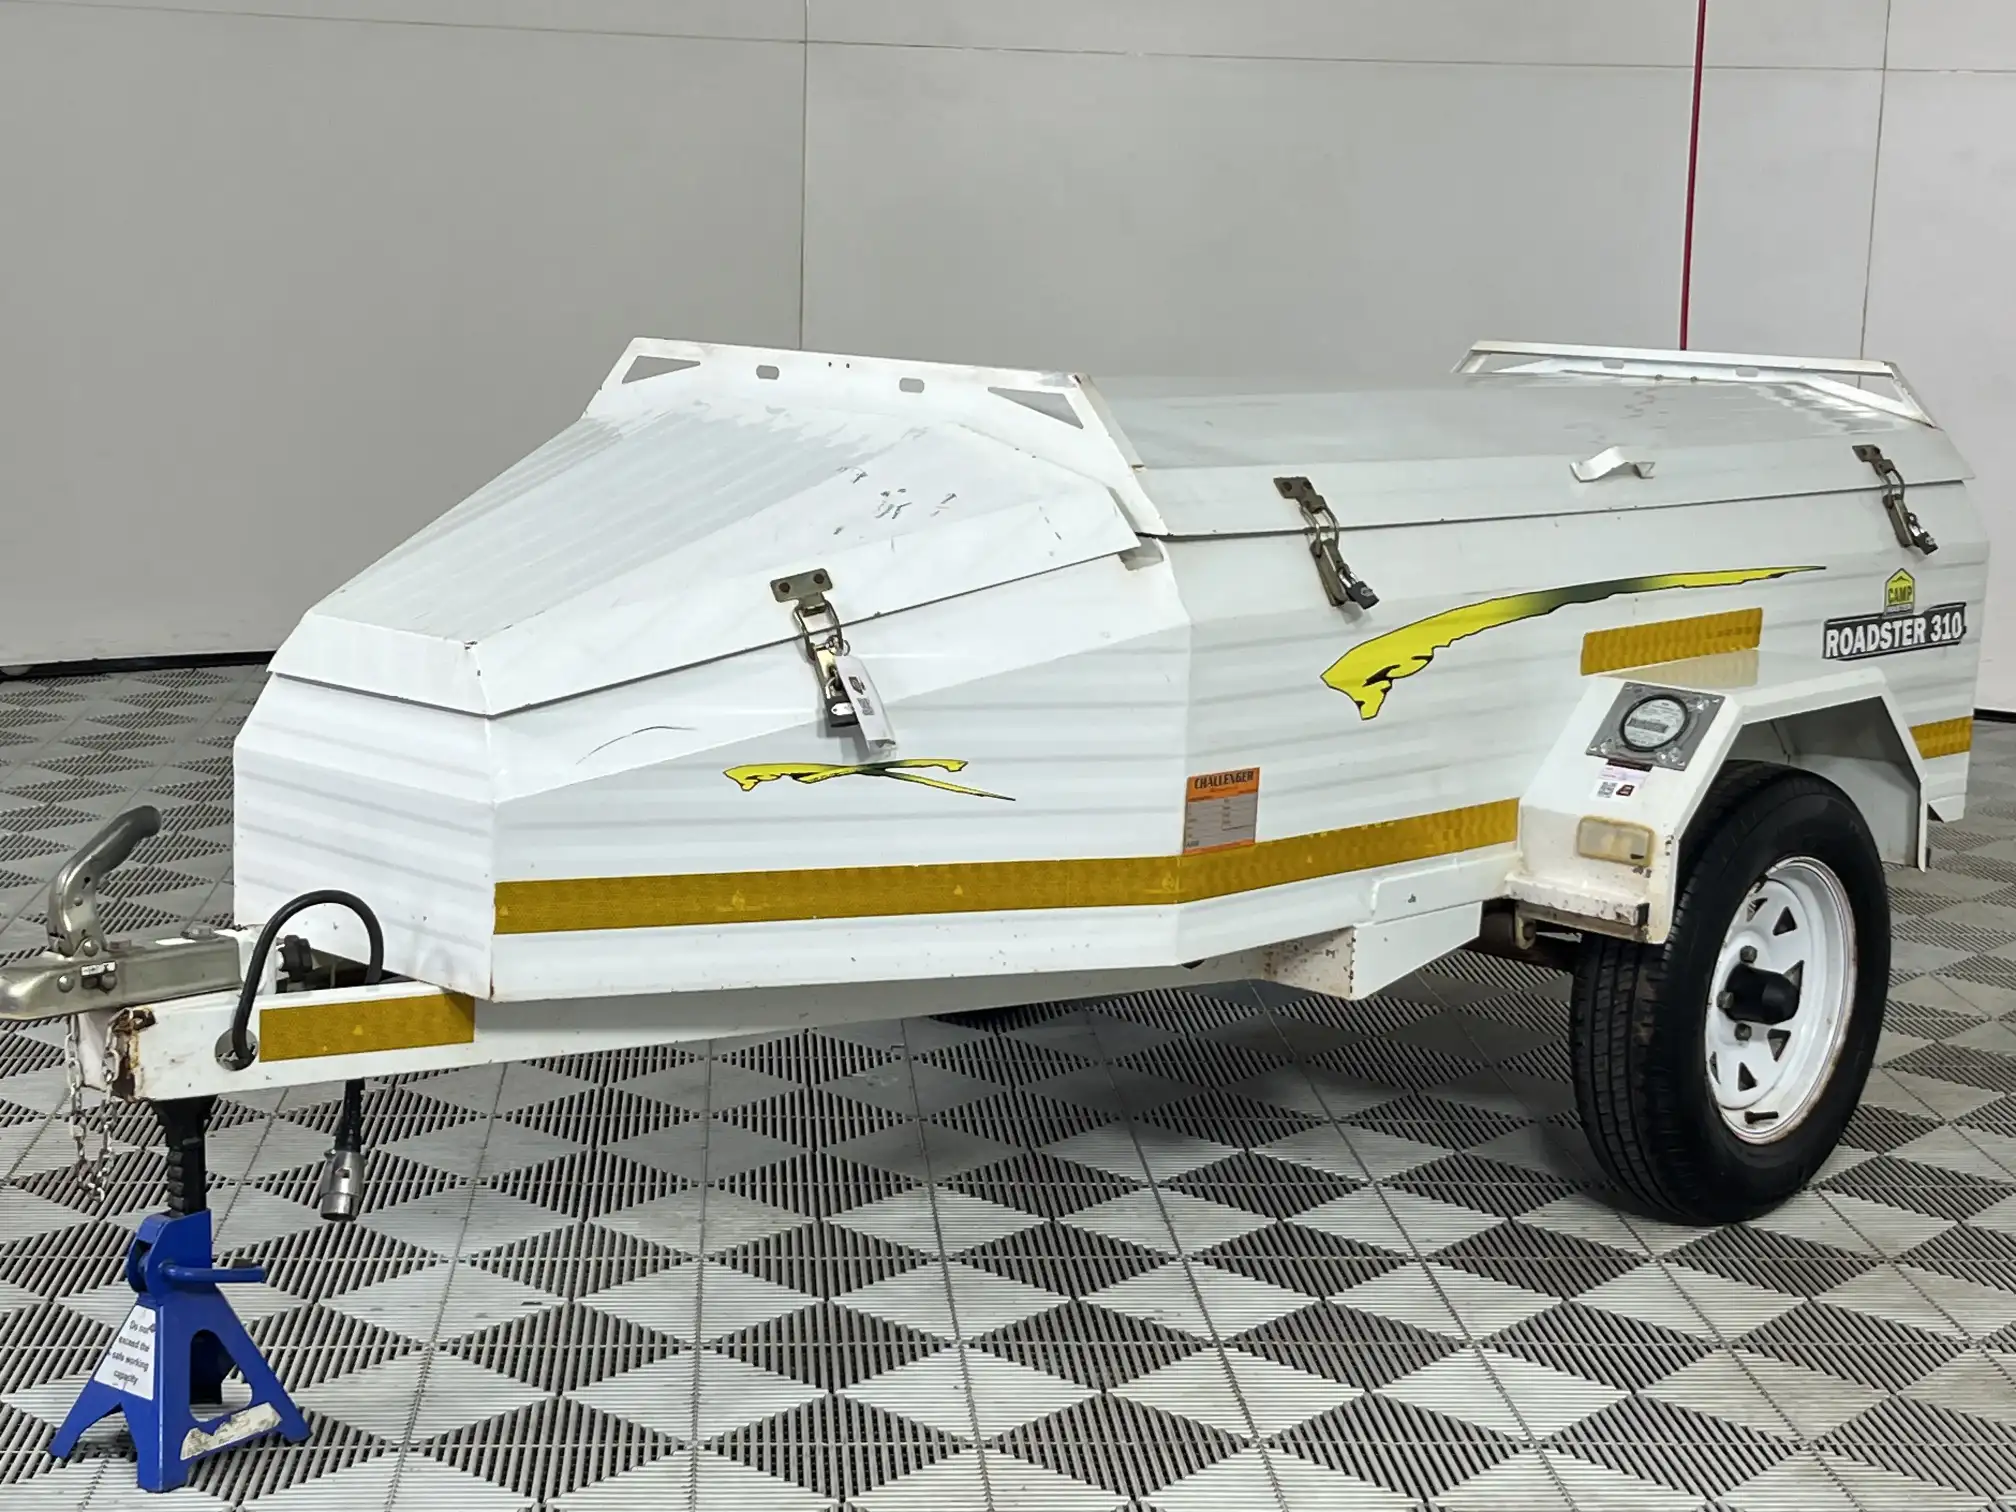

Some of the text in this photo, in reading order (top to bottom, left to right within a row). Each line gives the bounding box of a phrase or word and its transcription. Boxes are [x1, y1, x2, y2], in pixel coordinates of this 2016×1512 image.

[1888, 585, 1912, 604] CAMP
[1825, 611, 1962, 658] ROADSTER 310
[1194, 771, 1254, 790] CHALLENGER
[125, 1356, 149, 1372] working
